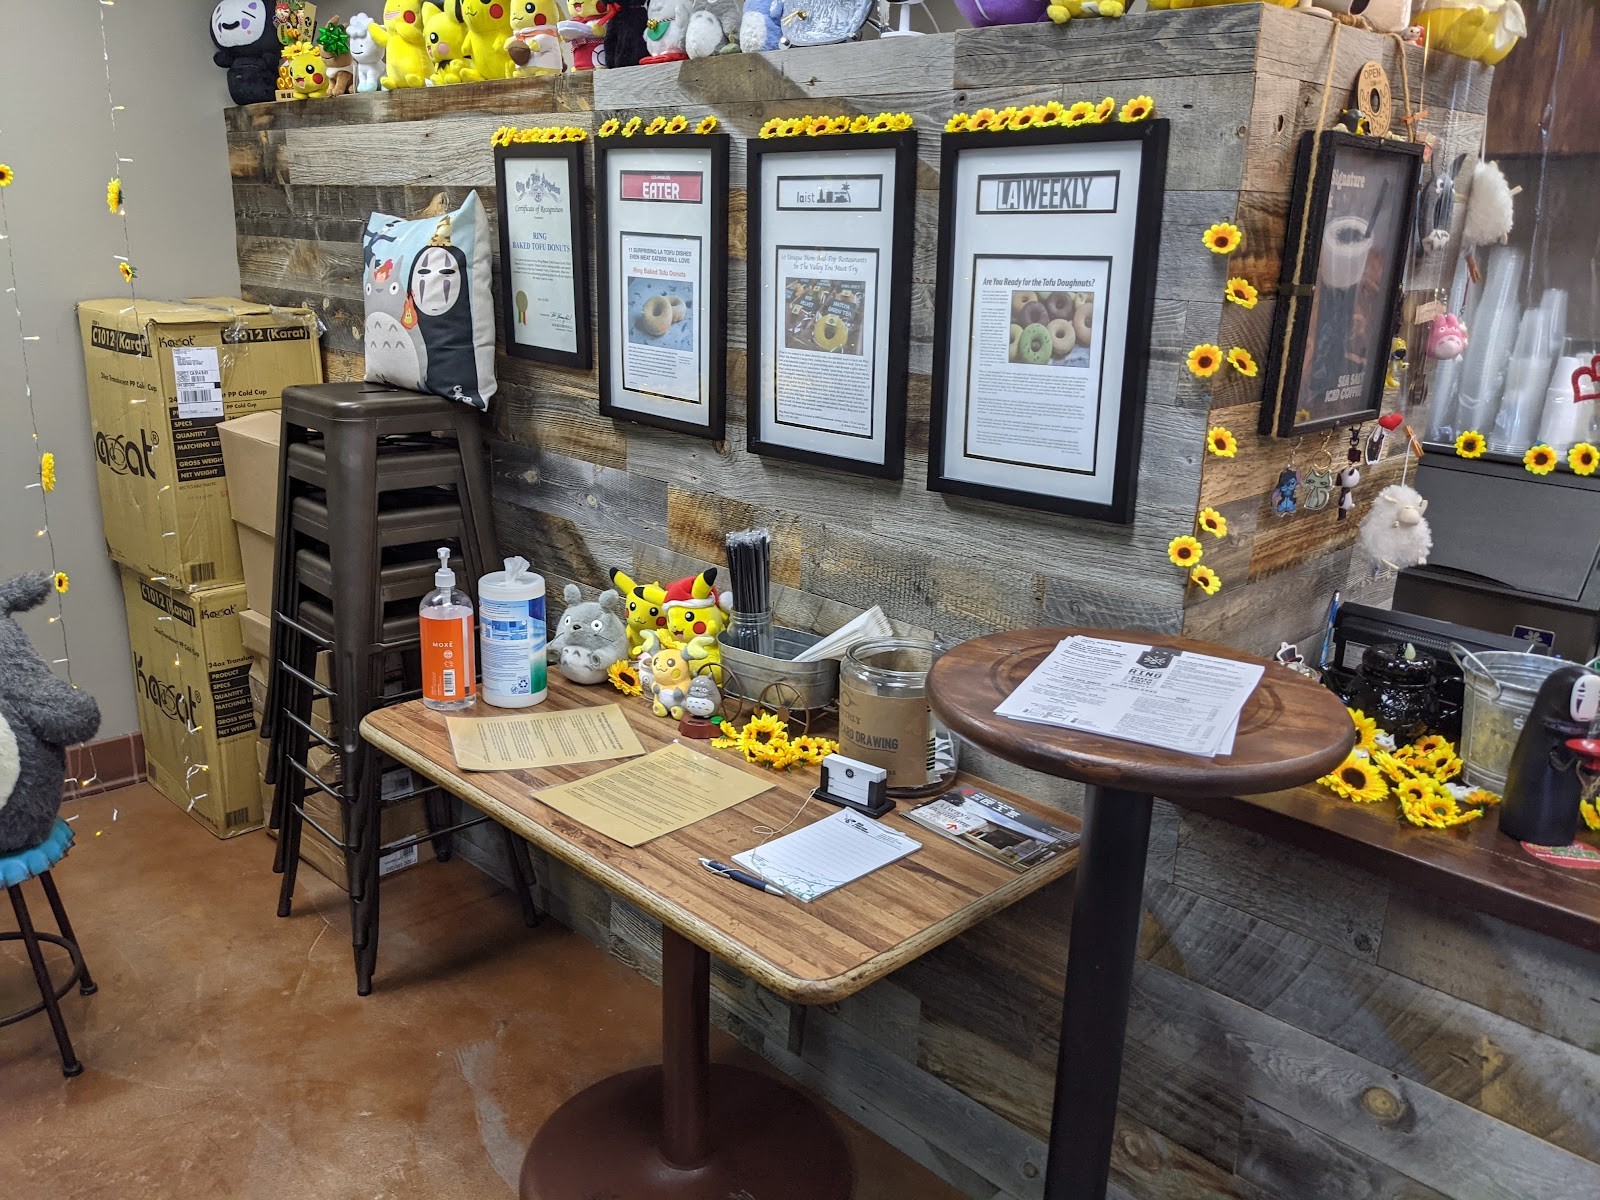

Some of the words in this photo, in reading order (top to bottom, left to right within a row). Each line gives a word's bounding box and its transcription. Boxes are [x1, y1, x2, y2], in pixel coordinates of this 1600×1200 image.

[1364, 68, 1380, 79] OPEN
[643, 182, 679, 200] EATER
[796, 192, 815, 203] laist
[535, 204, 540, 214] of
[533, 232, 547, 240] RING
[512, 241, 530, 249] BAKED
[547, 244, 570, 252] DONUTS
[1004, 278, 1021, 287] Ready
[1022, 278, 1031, 287] for
[1042, 279, 1056, 287] Tofu
[1057, 279, 1095, 288] Doughnuts?
[267, 328, 308, 341] (Karat)
[93, 328, 114, 347] C1012
[117, 332, 149, 356] (Karat)
[148, 384, 157, 393] Cup
[1324, 389, 1340, 402] ICED
[1340, 385, 1363, 400] COFFEE
[176, 431, 207, 439] QUANTITY
[177, 442, 210, 450] MATCHING
[95, 428, 156, 480] arat
[194, 469, 218, 477] WEIGHT
[142, 585, 165, 608] C1012
[211, 669, 239, 679] PRODUCT
[1128, 668, 1162, 678] RING
[214, 689, 244, 700] QUANTITY
[216, 699, 246, 710] MATCHING
[238, 712, 253, 720] WEIG
[231, 723, 253, 732] WEIGHT
[855, 731, 898, 750] DRAWING
